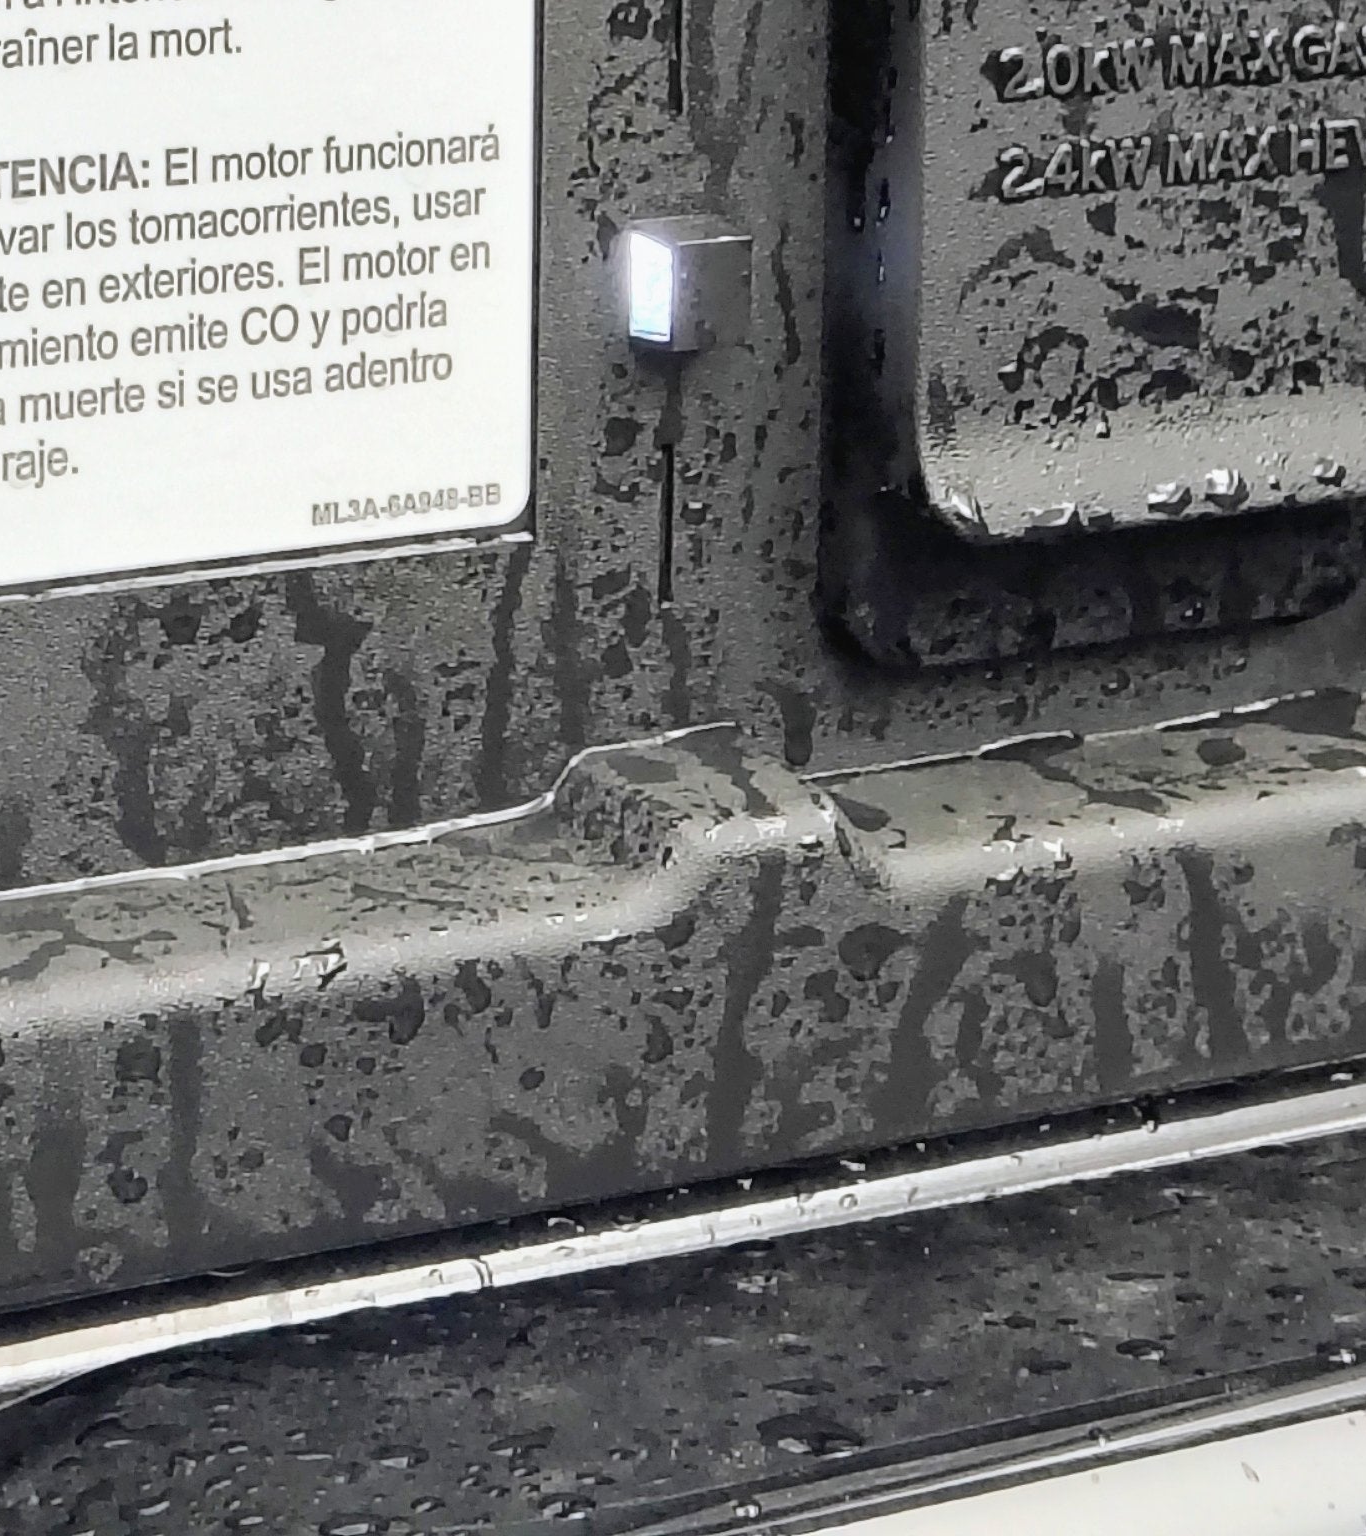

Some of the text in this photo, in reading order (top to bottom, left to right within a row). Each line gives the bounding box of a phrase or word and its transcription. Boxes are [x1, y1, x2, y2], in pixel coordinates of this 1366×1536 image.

[109, 23, 138, 61] la
[150, 18, 241, 58] mort.
[1169, 28, 1282, 90] MAX
[165, 147, 197, 186] El
[212, 143, 313, 182] motor
[323, 124, 499, 174] funcionará
[1166, 126, 1278, 184] MAX
[67, 212, 117, 250] los
[129, 194, 401, 250] tomacorrientes,
[414, 188, 486, 221] usar
[42, 277, 86, 309] en
[99, 258, 283, 303] exteriores.
[299, 246, 329, 285] El
[343, 242, 440, 281] motor
[451, 241, 490, 271] en
[131, 313, 227, 356] emite
[241, 304, 299, 345] CO
[311, 310, 330, 349] y
[342, 291, 446, 342] podría
[20, 378, 145, 423] muerte
[158, 380, 184, 409] si
[198, 375, 238, 405] se
[252, 367, 312, 399] usa
[325, 348, 452, 392] adentro
